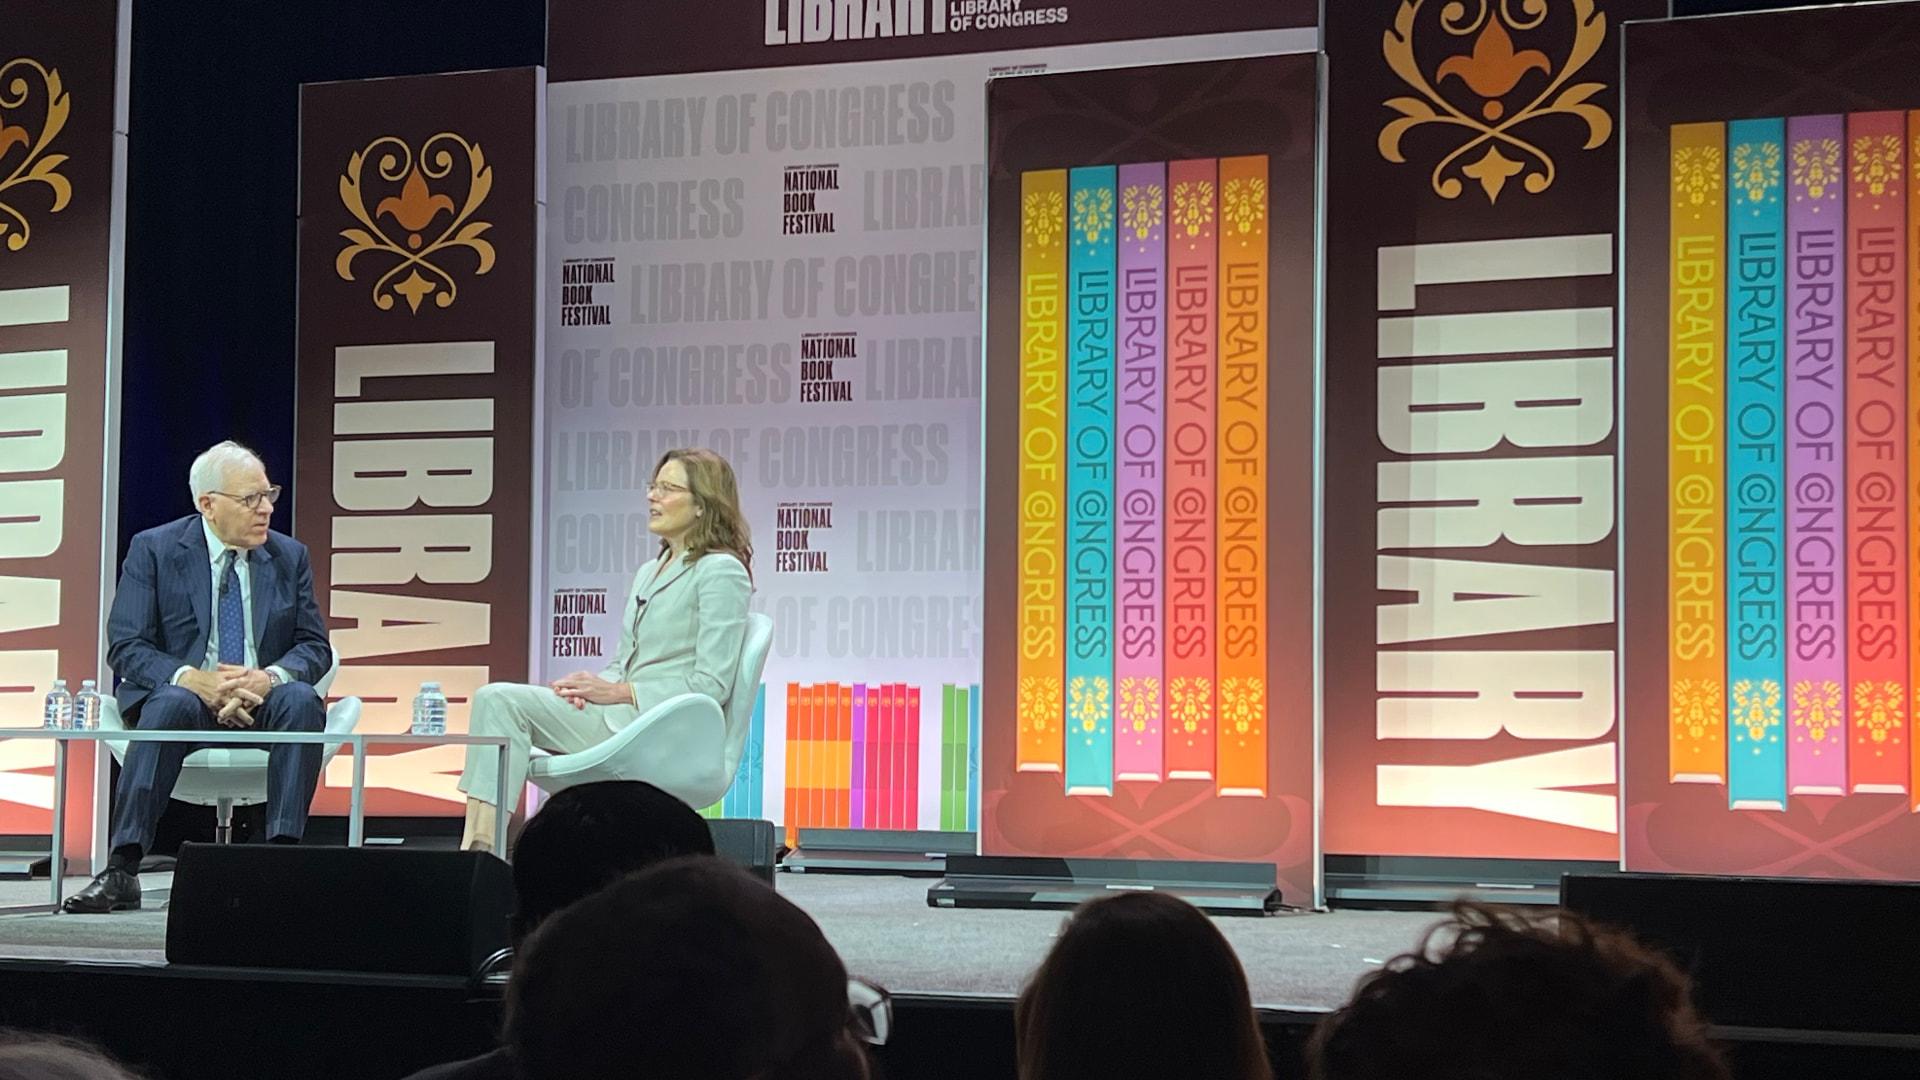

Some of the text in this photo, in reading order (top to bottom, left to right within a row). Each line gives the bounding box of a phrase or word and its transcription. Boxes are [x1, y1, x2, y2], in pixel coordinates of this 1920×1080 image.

[950, 0, 1021, 16] LIBRARY
[950, 7, 1068, 32] OF CONGRESS
[566, 80, 956, 164] LIBRARY OF CONGRESS
[784, 169, 839, 192] NATIONAL
[563, 177, 744, 245] CONGRESS
[783, 212, 835, 235] FESTIVAL
[784, 192, 815, 213] BOOK
[562, 285, 592, 305] BOOK
[563, 263, 615, 284] NATIONAL
[630, 250, 983, 325] LIBRARY OF CONGRE
[561, 305, 611, 326] FESTIVAL
[801, 338, 857, 359] NATIONAL
[801, 360, 832, 380] BOOK
[560, 343, 792, 409] OF CONGRESS
[800, 381, 852, 402] FESTIVAL
[758, 423, 949, 487] CONGRESS
[1023, 273, 1057, 659] LIBRARY OF CONGRESS
[1075, 270, 1108, 659] LIBRARY OF CONGRESS
[1122, 267, 1157, 659] LIBRARY OF CONGRESS
[1173, 265, 1208, 659] LIBRARY OF CONGRESS
[1224, 262, 1259, 659] LIBRARY OF CONGRESS
[1675, 235, 1715, 660] LIBRARY OF CONGRESS
[1737, 232, 1777, 661] LIBRARY OF CONGRESS
[1795, 229, 1835, 661] LIBRARY OF CONGRESS
[1856, 227, 1897, 662] LIBRARY OF CONGRESS
[777, 508, 832, 528] NATIONAL
[1376, 233, 1618, 834] LIBRARY
[776, 551, 828, 572] FESTIVAL
[777, 530, 808, 550] BOOK
[325, 341, 495, 806] LIBRARY
[553, 616, 584, 635] BOOK
[554, 594, 607, 614] NATIONAL
[553, 636, 602, 656] FESTIVAL
[775, 596, 818, 658] OF
